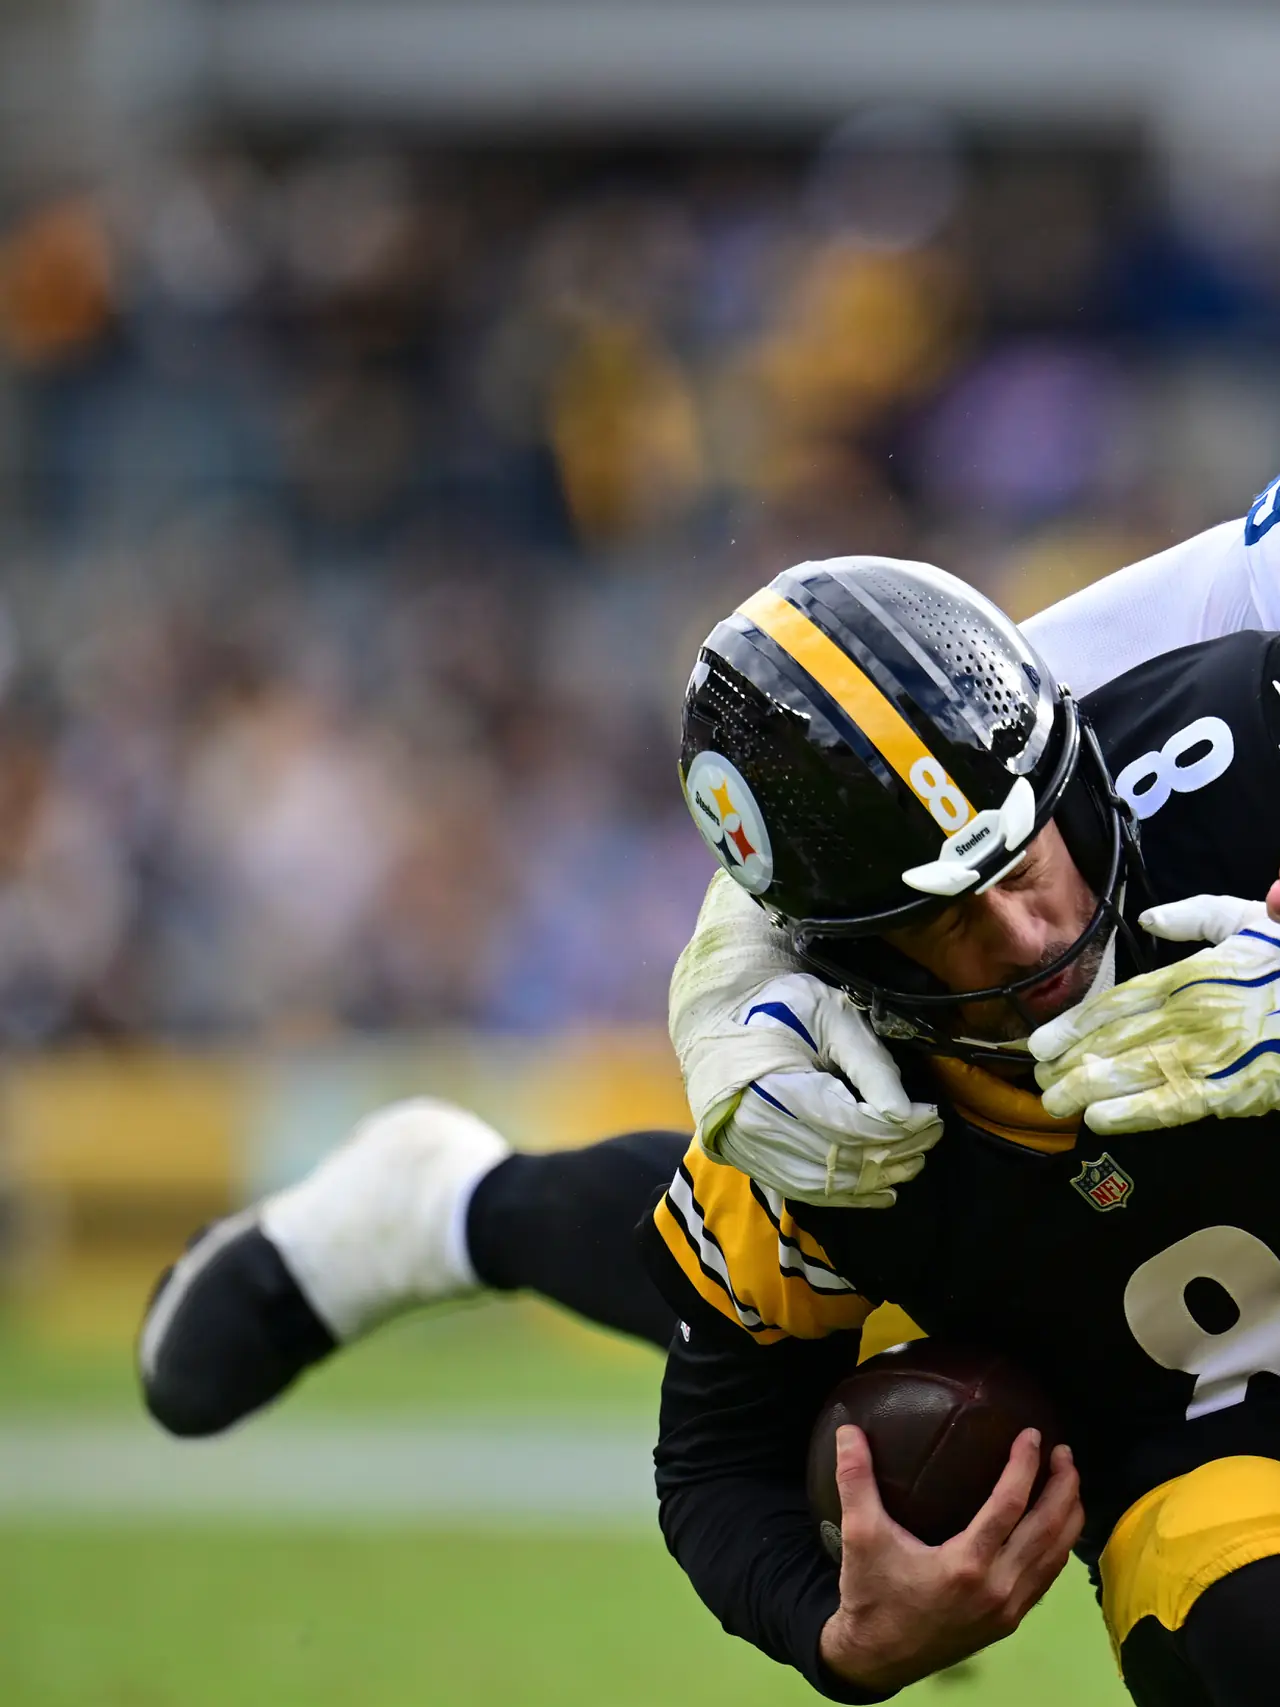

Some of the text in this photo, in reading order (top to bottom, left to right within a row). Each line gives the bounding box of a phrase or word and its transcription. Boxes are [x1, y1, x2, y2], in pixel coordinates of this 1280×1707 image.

[1114, 716, 1235, 820] 8
[695, 790, 721, 828] Steelers
[909, 755, 970, 832] 8
[955, 826, 991, 856] Steelers
[1090, 1175, 1128, 1206] NFL
